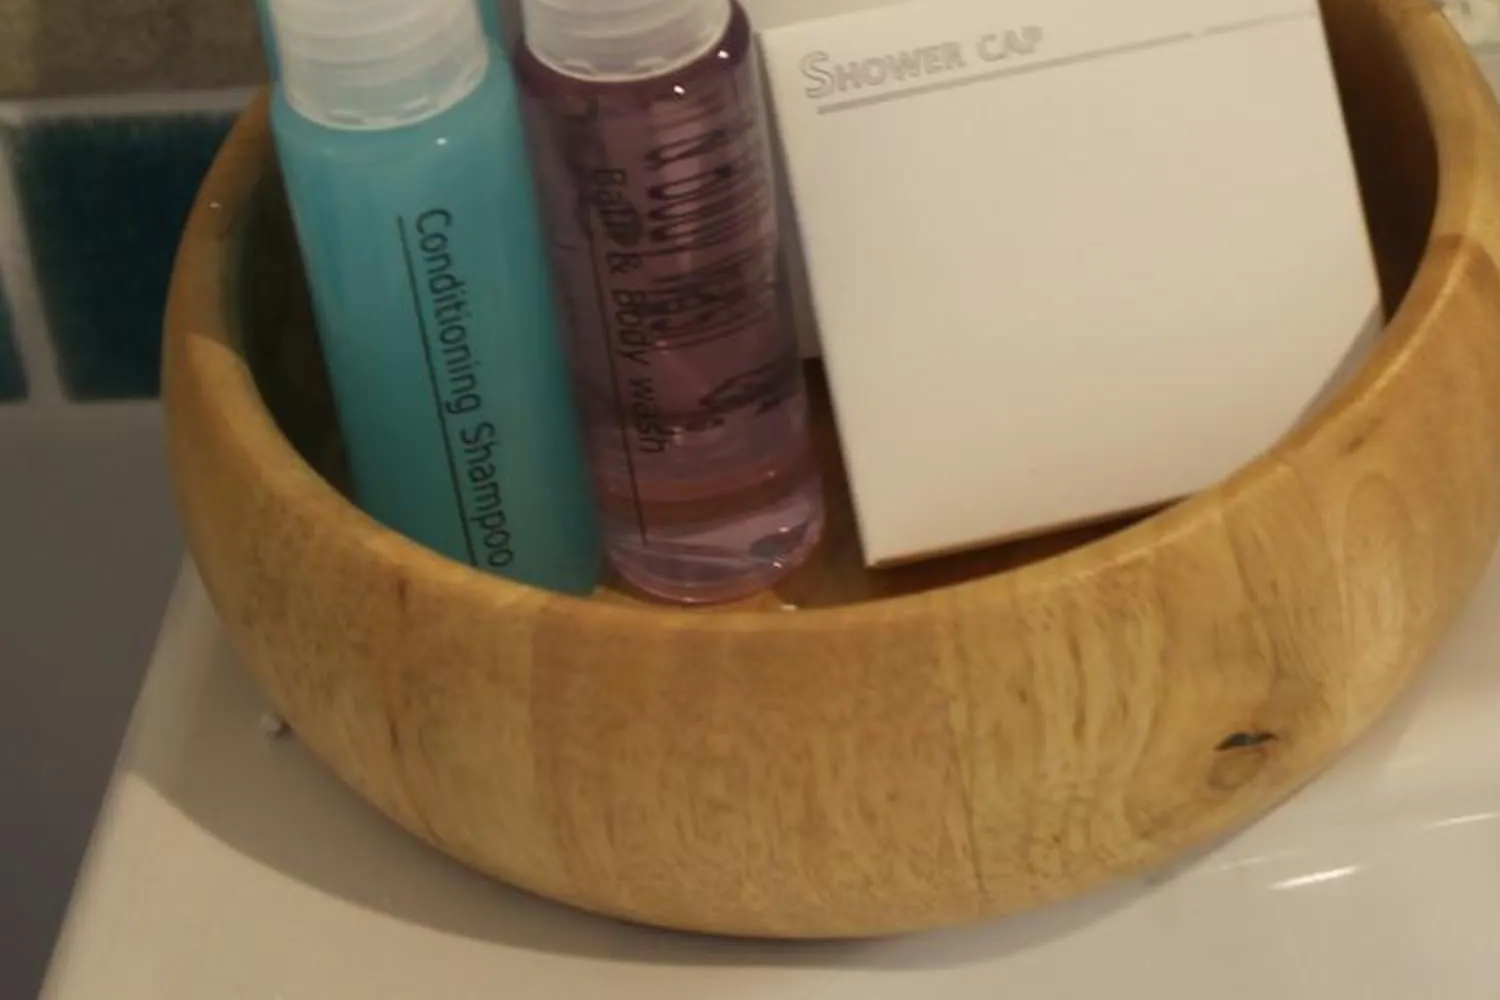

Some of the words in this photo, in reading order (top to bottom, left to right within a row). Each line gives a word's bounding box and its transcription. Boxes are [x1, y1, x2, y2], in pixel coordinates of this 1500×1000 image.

[800, 41, 966, 99] SHOWER
[414, 207, 482, 415] Conditioning
[460, 421, 515, 568] Shampoo
